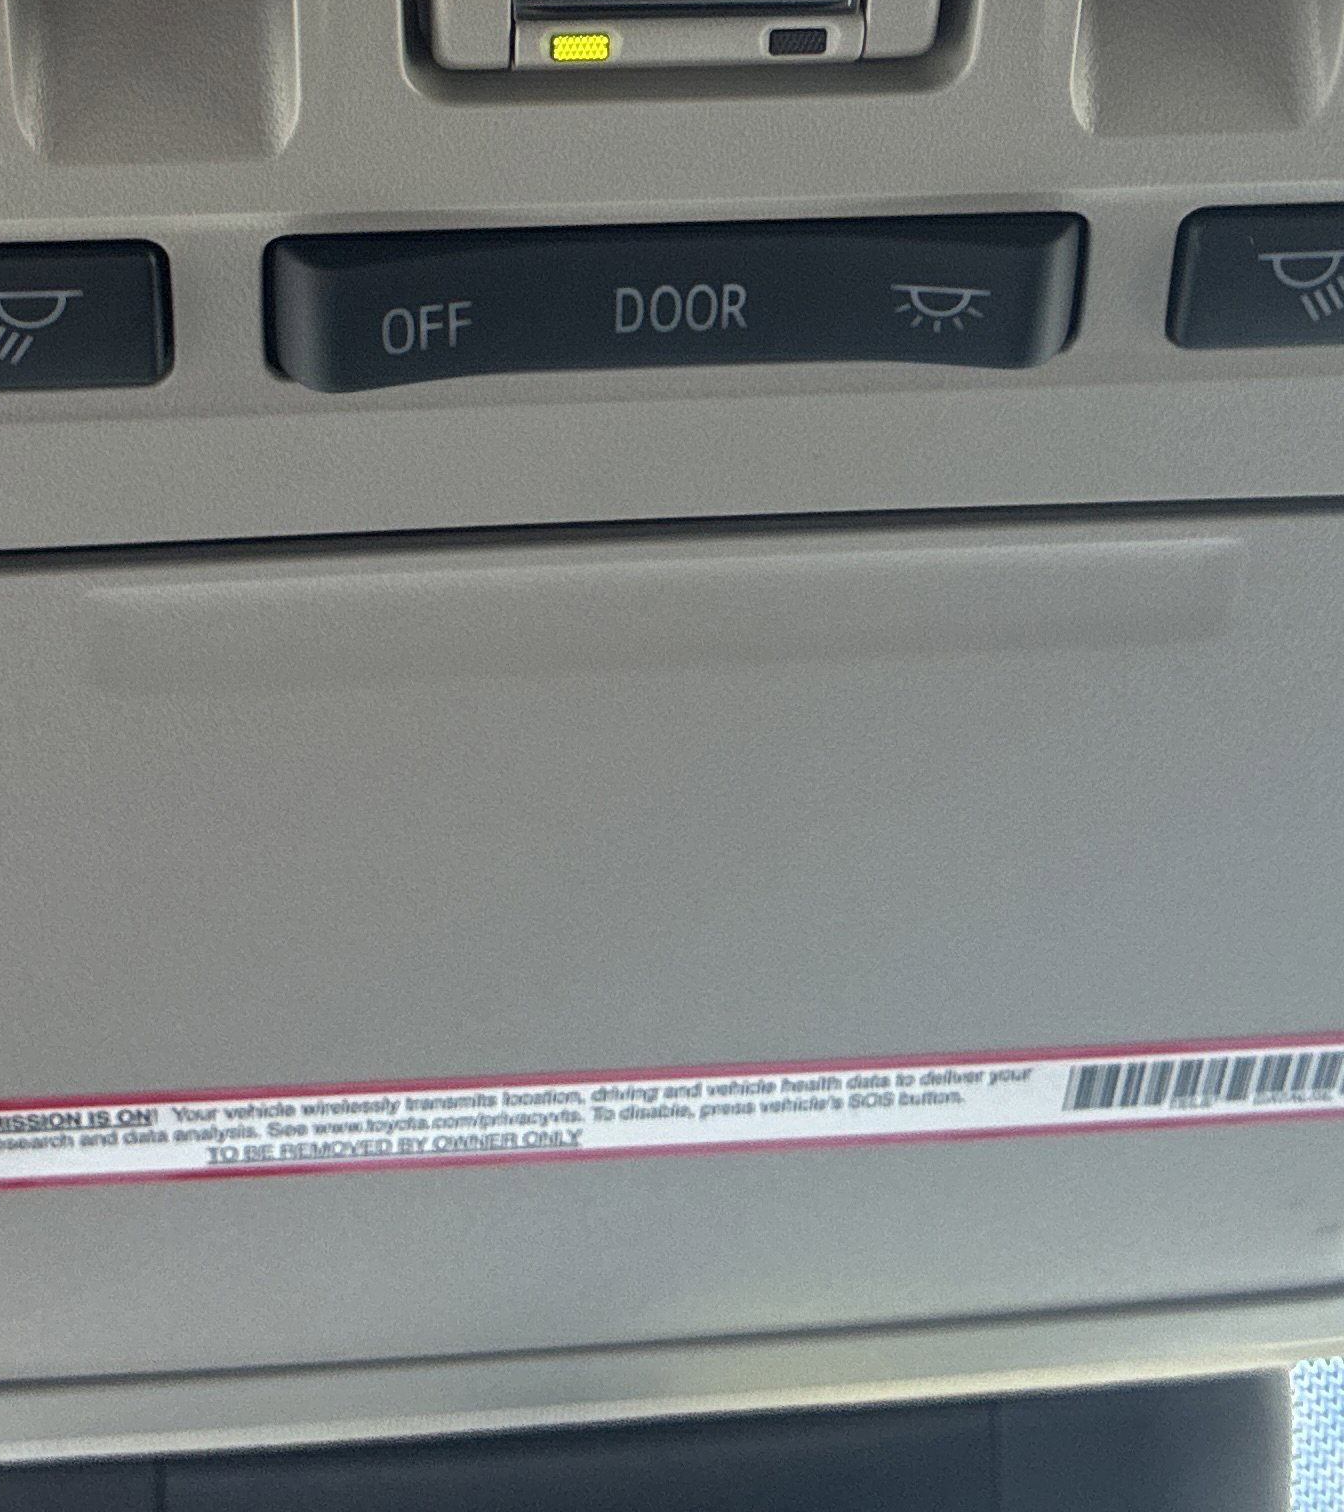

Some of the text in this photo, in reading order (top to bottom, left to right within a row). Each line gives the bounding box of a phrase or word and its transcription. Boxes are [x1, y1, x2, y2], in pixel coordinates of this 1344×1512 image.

[381, 283, 748, 356] OFF DOOR
[80, 1131, 119, 1148] and
[122, 1128, 169, 1145] data
[173, 1123, 261, 1144] analysis.
[266, 1121, 306, 1138] See
[592, 1105, 616, 1121] To
[619, 1102, 696, 1121] disable,
[699, 1101, 755, 1121] press
[760, 1095, 843, 1114] vehicle's
[848, 1091, 894, 1109] SOS
[898, 1089, 965, 1106] button.
[87, 1110, 110, 1127] IS
[172, 1105, 217, 1123] Your
[224, 1101, 294, 1119] vehicle
[300, 1096, 401, 1117] wirelessly
[405, 1093, 498, 1111] transmits
[501, 1089, 586, 1108] location,
[590, 1085, 659, 1105] driving
[663, 1082, 702, 1099] and
[706, 1079, 776, 1097] vehicle
[780, 1076, 842, 1094] health
[845, 1074, 891, 1090] data
[895, 1072, 915, 1087] to
[919, 1069, 985, 1087] deliver
[989, 1067, 1034, 1086] your
[208, 1128, 583, 1163] TO BE REMOVED BY OWNER ONLY
